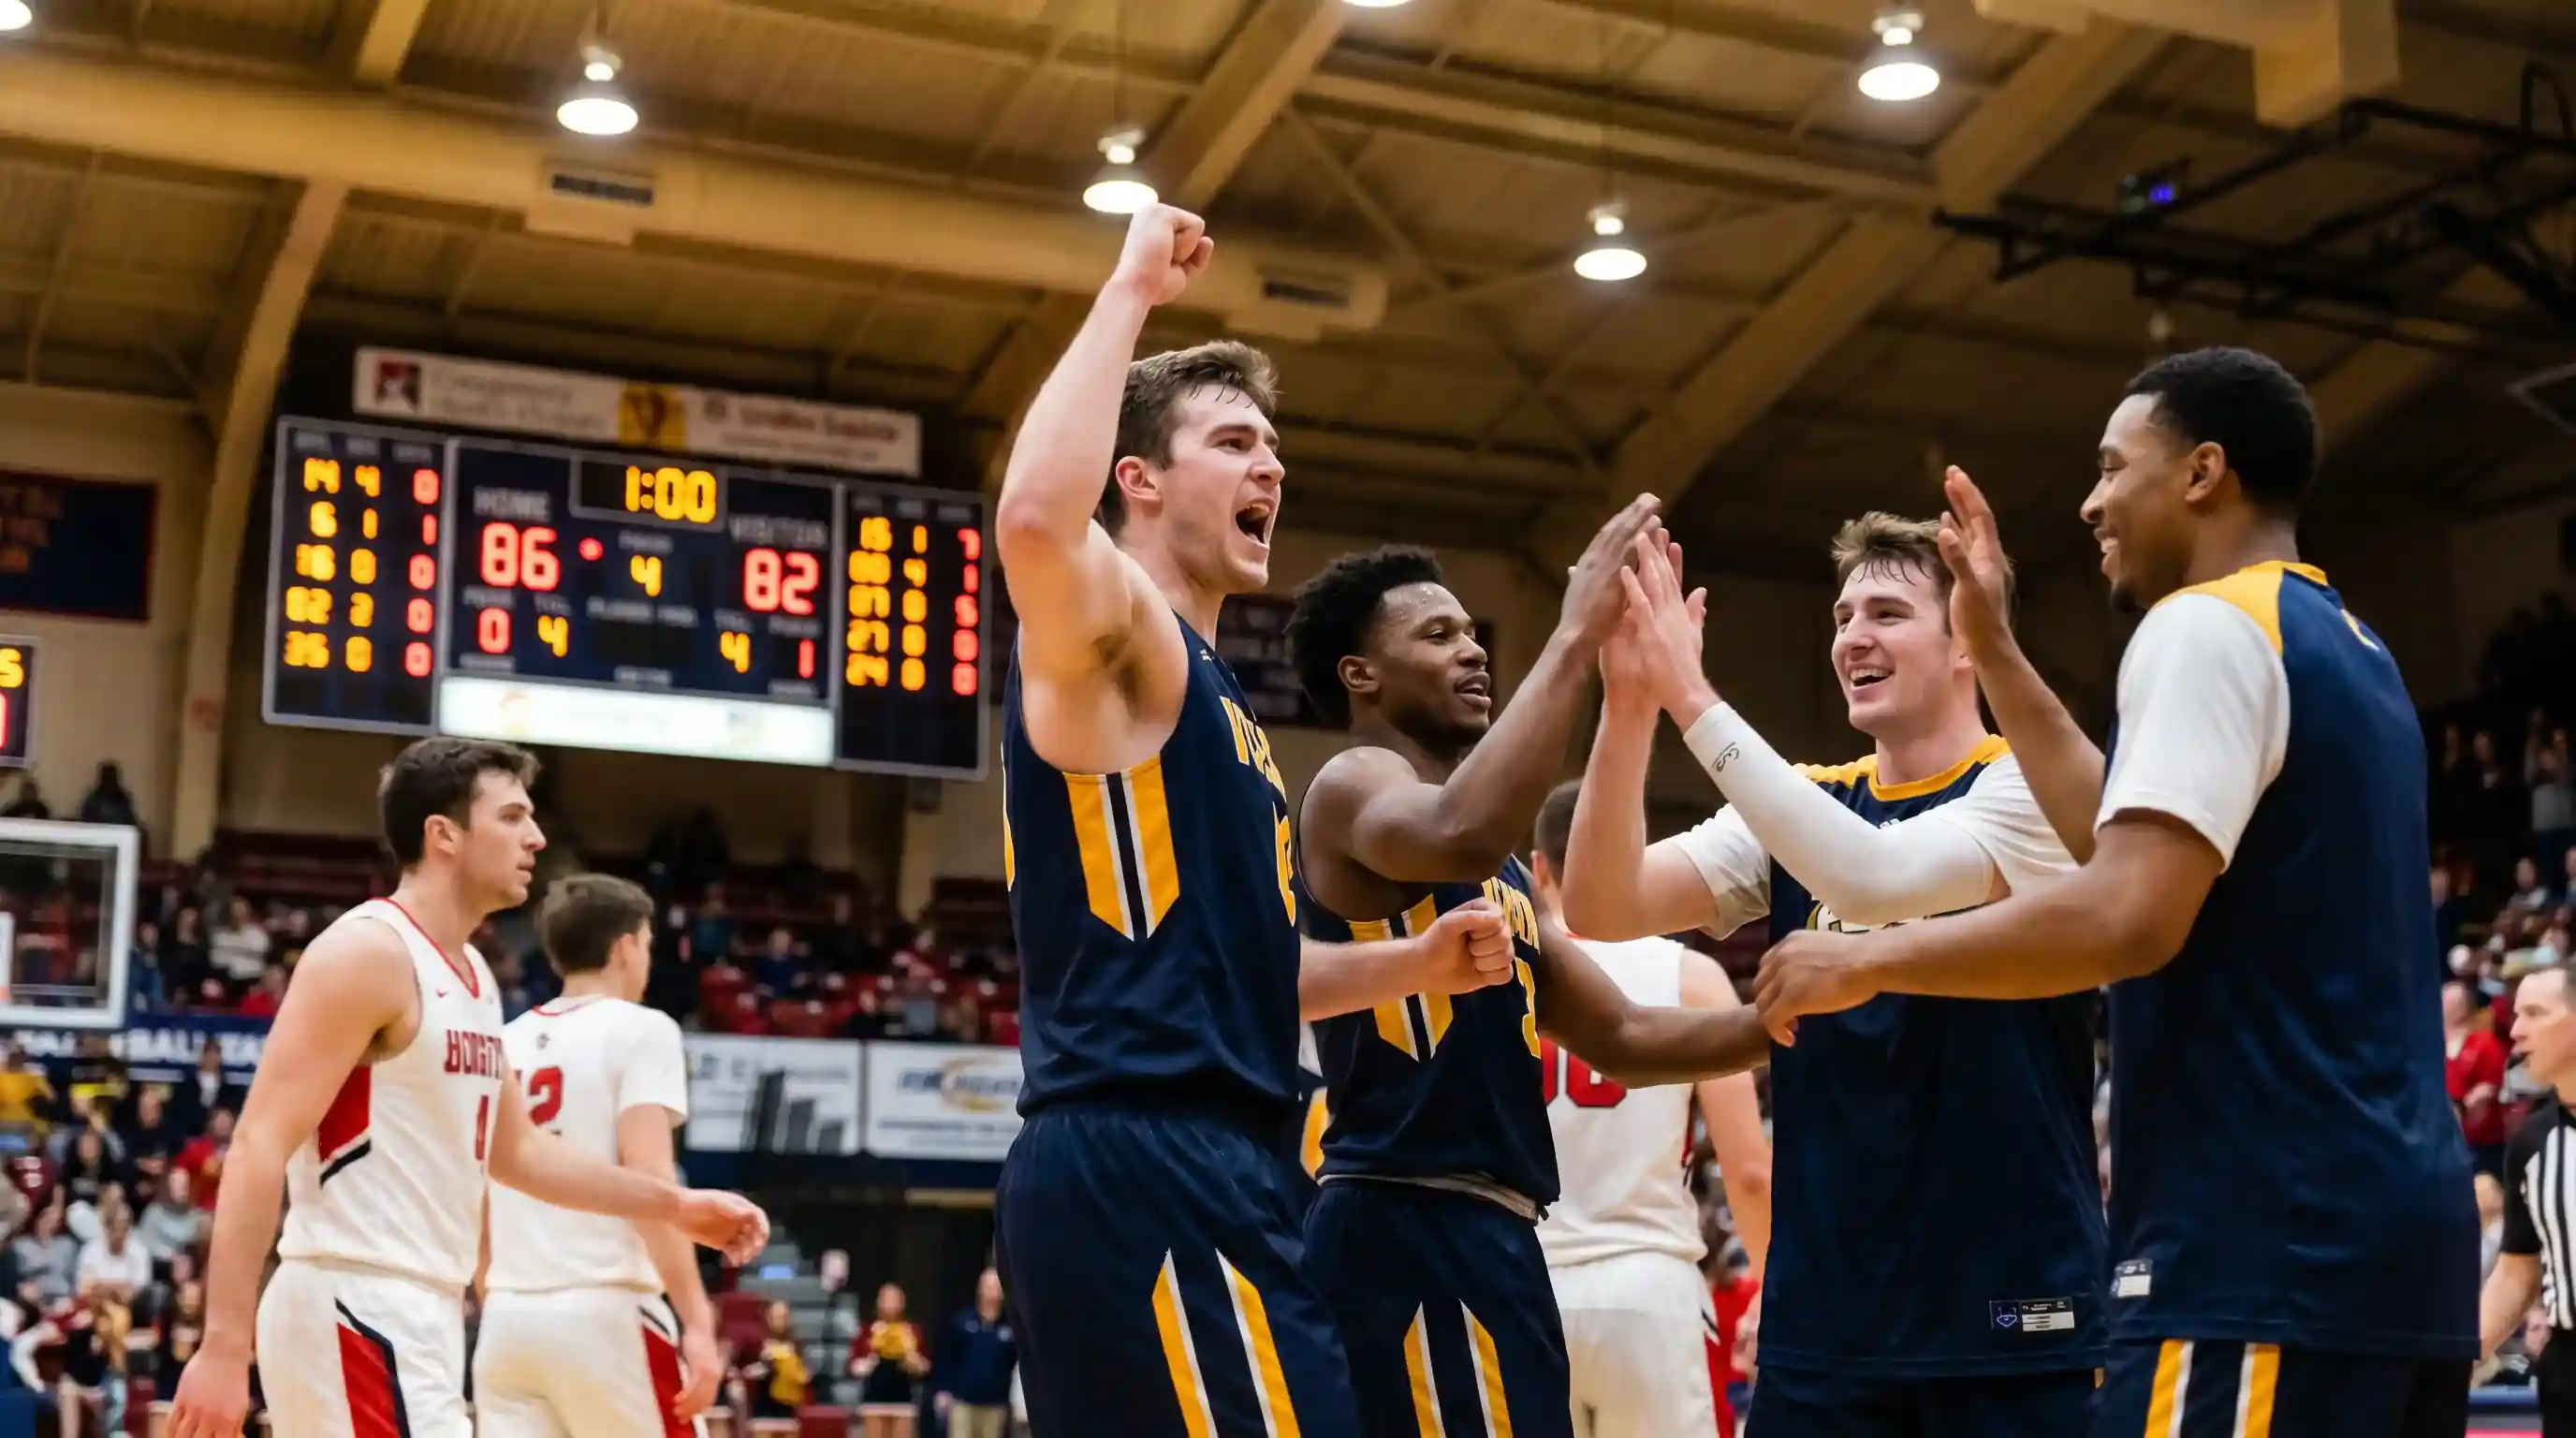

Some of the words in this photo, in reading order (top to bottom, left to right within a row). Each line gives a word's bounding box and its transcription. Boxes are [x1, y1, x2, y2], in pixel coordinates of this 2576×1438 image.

[625, 465, 717, 523] 1:00
[480, 521, 561, 592] 86
[630, 554, 662, 596] 4
[743, 548, 819, 615] 82
[478, 607, 510, 653] 0
[537, 615, 568, 657] 4
[720, 631, 750, 673] 4
[798, 639, 814, 678] 1
